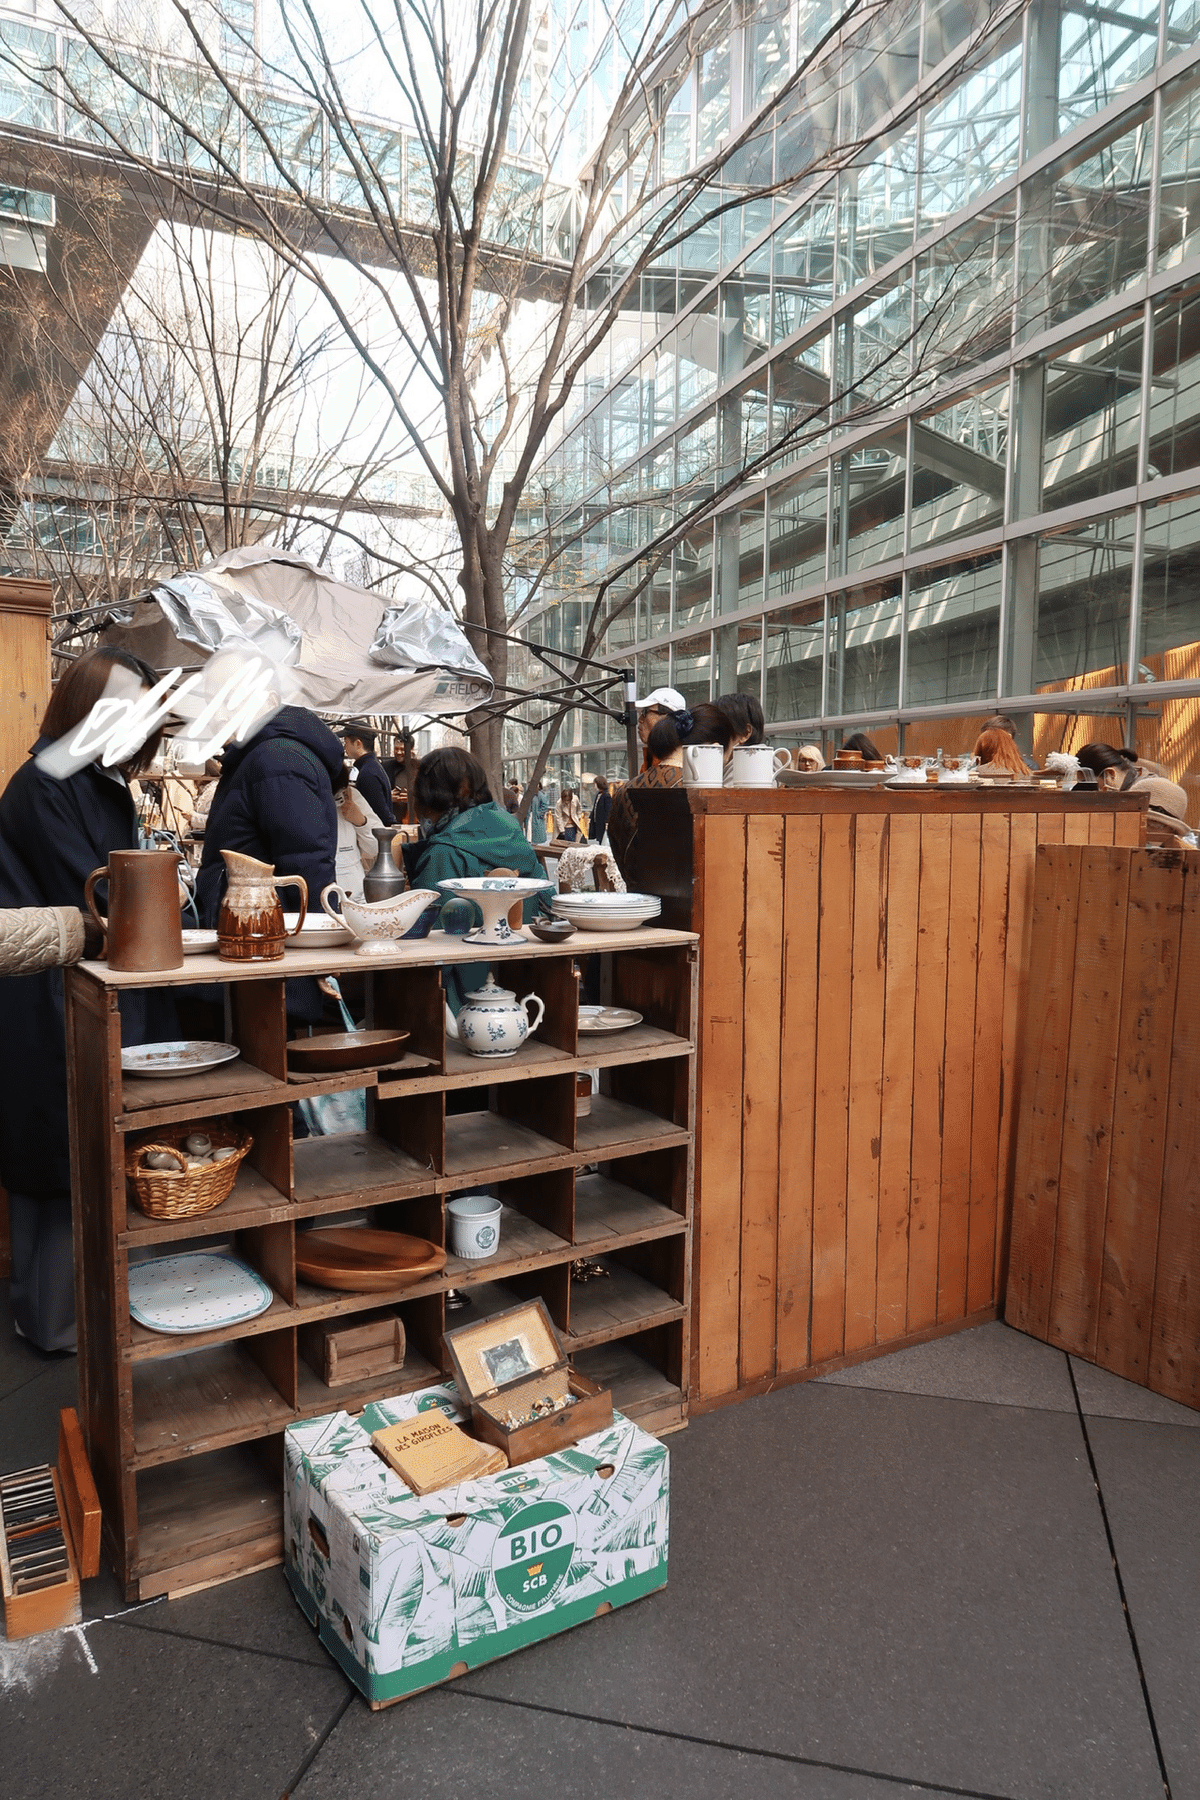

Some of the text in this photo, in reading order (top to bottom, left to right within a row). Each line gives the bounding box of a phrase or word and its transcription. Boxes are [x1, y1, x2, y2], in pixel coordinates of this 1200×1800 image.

[396, 1435, 410, 1444] LA
[410, 1423, 441, 1438] MAISON
[394, 1443, 410, 1452] DES
[502, 1475, 529, 1487] BIO
[511, 1524, 562, 1561] BIO
[522, 1574, 548, 1593] SCB
[505, 1593, 536, 1612] COMPAGNIE
